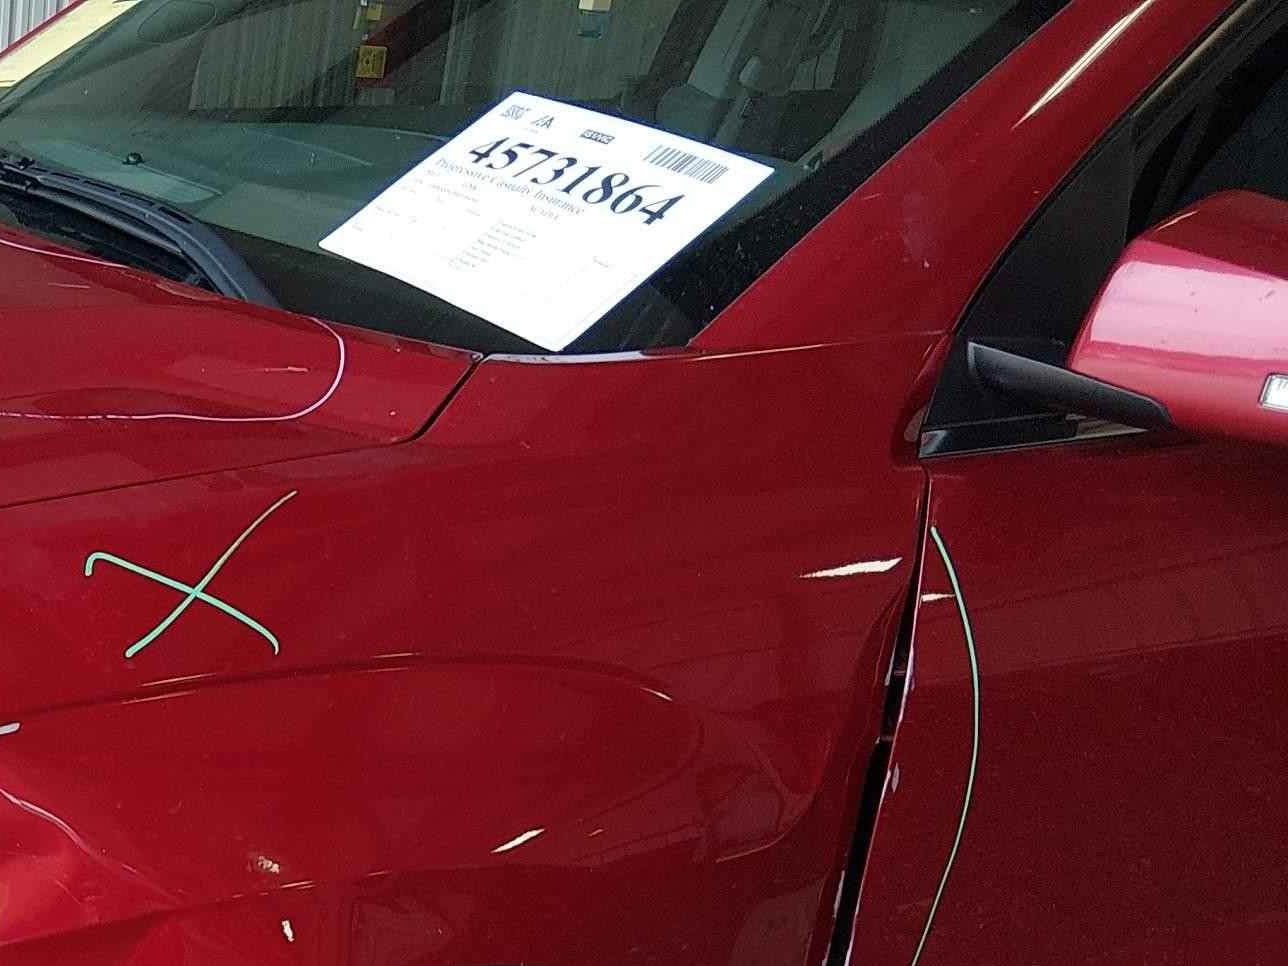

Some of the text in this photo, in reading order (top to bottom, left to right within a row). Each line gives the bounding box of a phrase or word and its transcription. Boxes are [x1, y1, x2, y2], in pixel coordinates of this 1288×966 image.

[435, 157, 491, 183] Progressive
[534, 187, 586, 216] Insurance
[468, 137, 686, 226] 45731864
